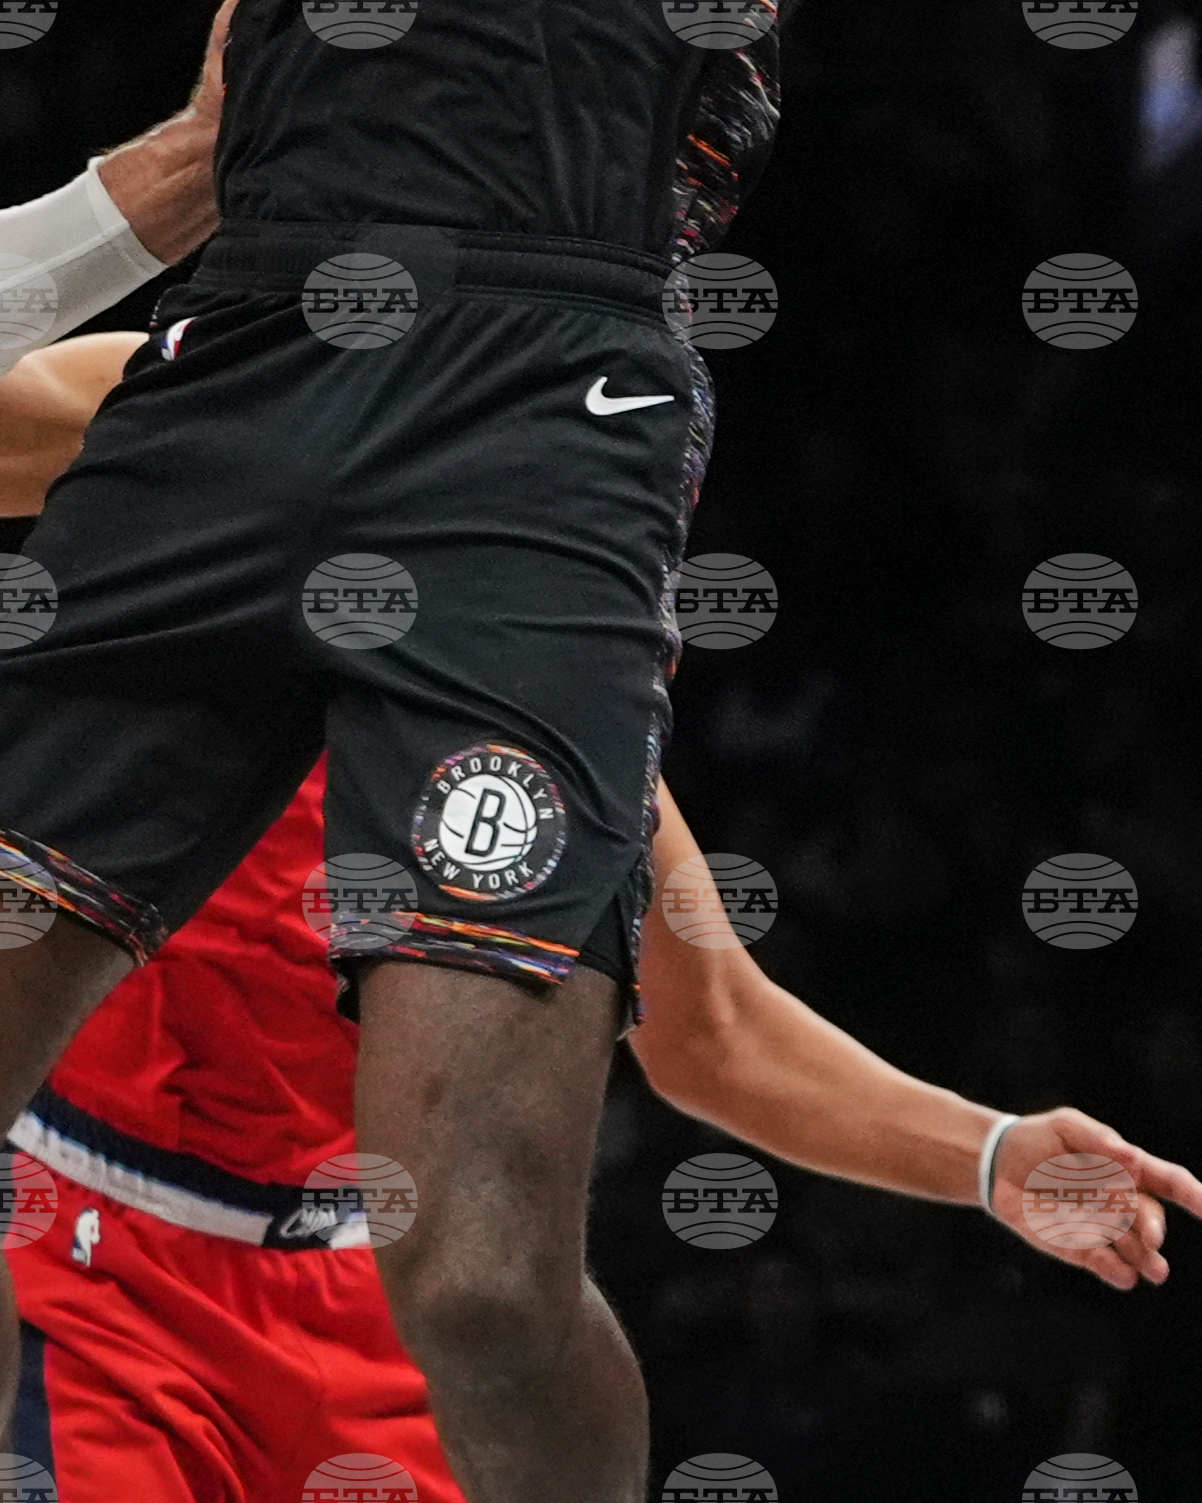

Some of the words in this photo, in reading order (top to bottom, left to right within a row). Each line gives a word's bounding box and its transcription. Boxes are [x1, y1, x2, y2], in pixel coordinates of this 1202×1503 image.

[436, 755, 555, 820] BROOKLYN
[464, 786, 507, 858] B
[423, 838, 461, 881] NEW
[472, 860, 534, 889] YORK
